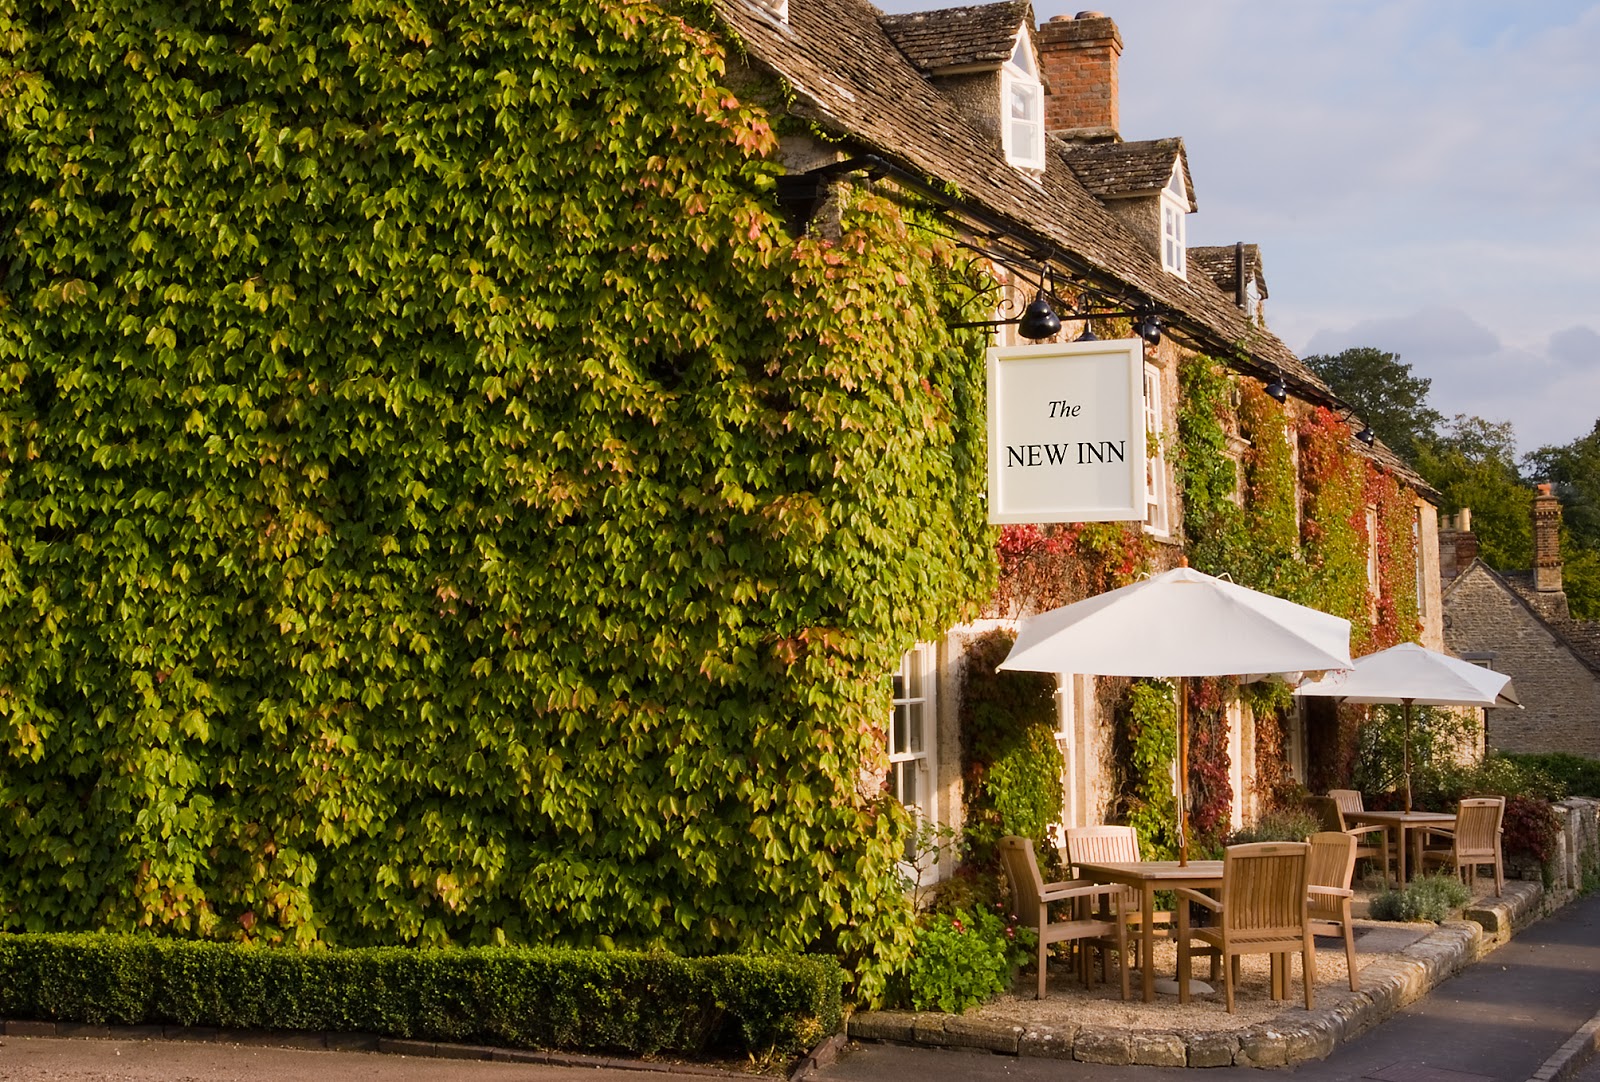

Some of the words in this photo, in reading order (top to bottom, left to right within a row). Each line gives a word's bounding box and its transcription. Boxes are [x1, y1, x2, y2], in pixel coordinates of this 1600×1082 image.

[1048, 400, 1081, 418] The
[1006, 443, 1069, 467] NEW
[1076, 440, 1126, 465] INN
